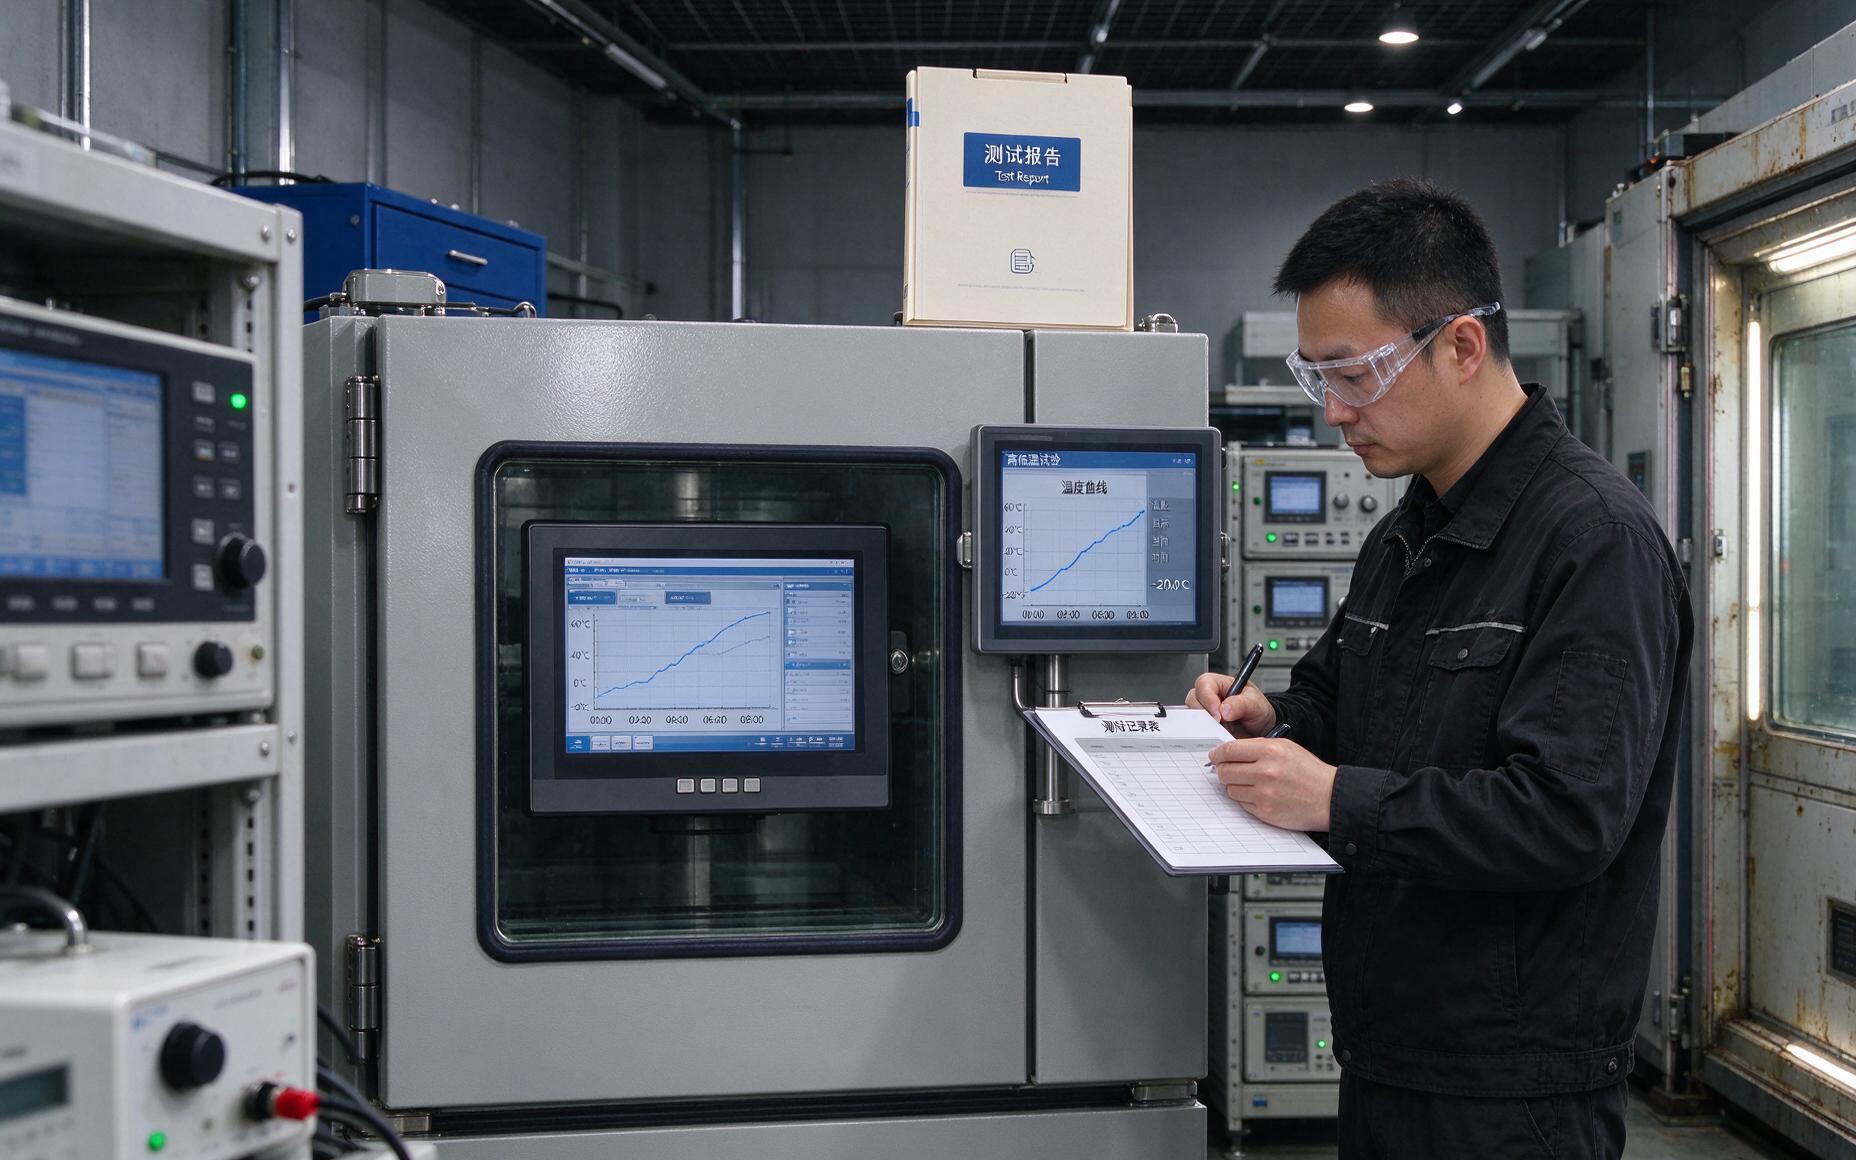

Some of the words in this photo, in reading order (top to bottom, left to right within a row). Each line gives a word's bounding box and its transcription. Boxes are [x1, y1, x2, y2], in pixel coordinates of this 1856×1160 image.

[984, 144, 1061, 167] 测试报告
[995, 170, 1015, 182] Test
